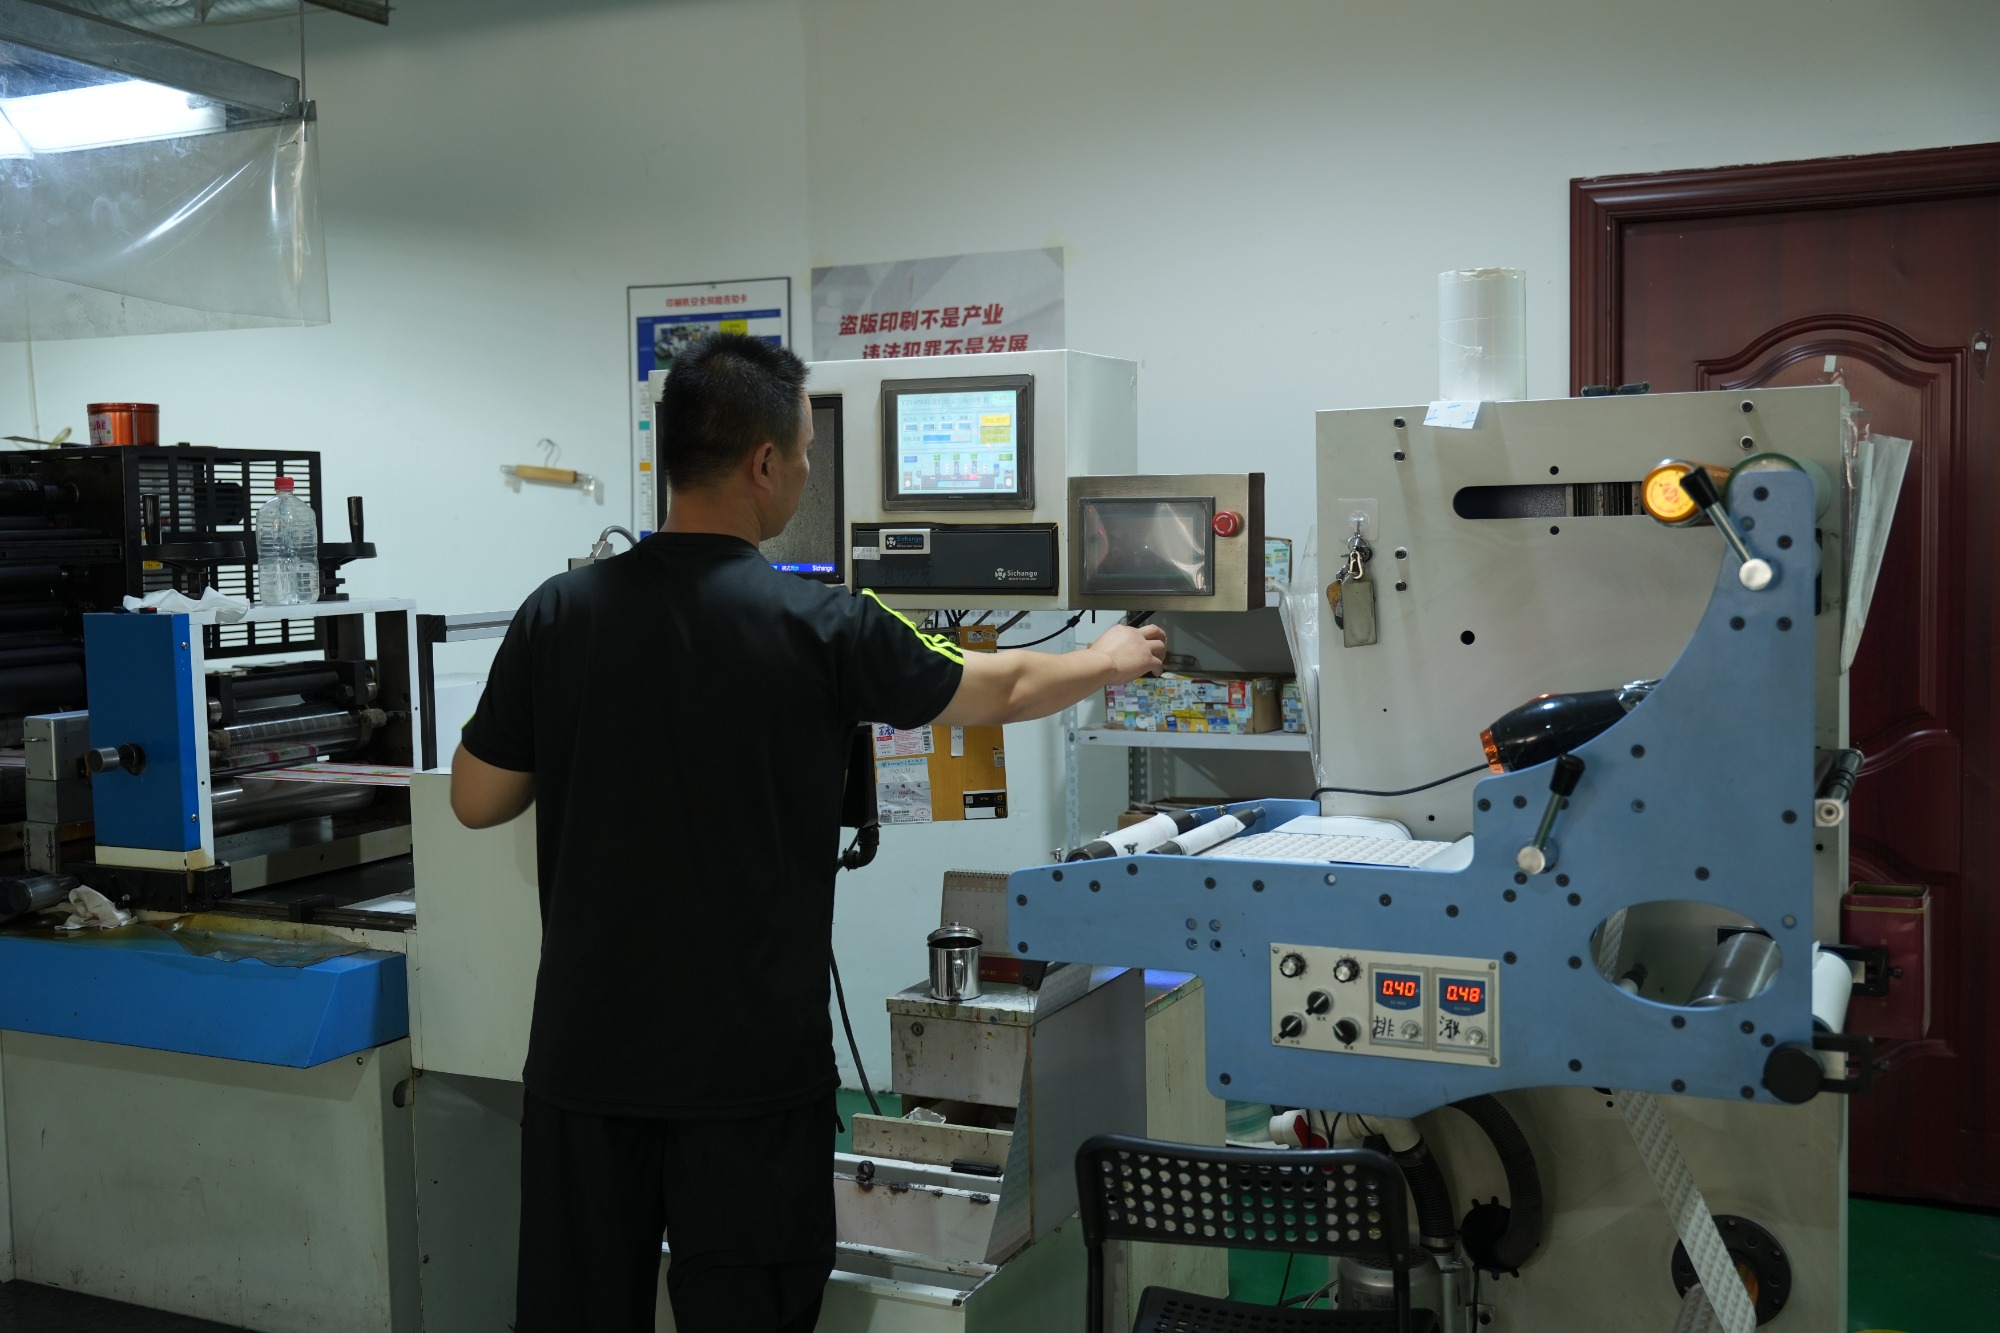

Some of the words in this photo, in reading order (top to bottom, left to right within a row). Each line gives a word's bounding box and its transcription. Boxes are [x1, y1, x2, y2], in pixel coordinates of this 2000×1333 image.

[838, 303, 1005, 336] 盗版印刷不是产业
[862, 334, 1029, 359] 违法犯罪不是发展
[1007, 569, 1038, 578] Sichango
[1382, 980, 1416, 997] 0.40
[1446, 985, 1481, 1003] 0.48
[1372, 1015, 1395, 1038] 排
[1438, 1015, 1461, 1039] 涨
